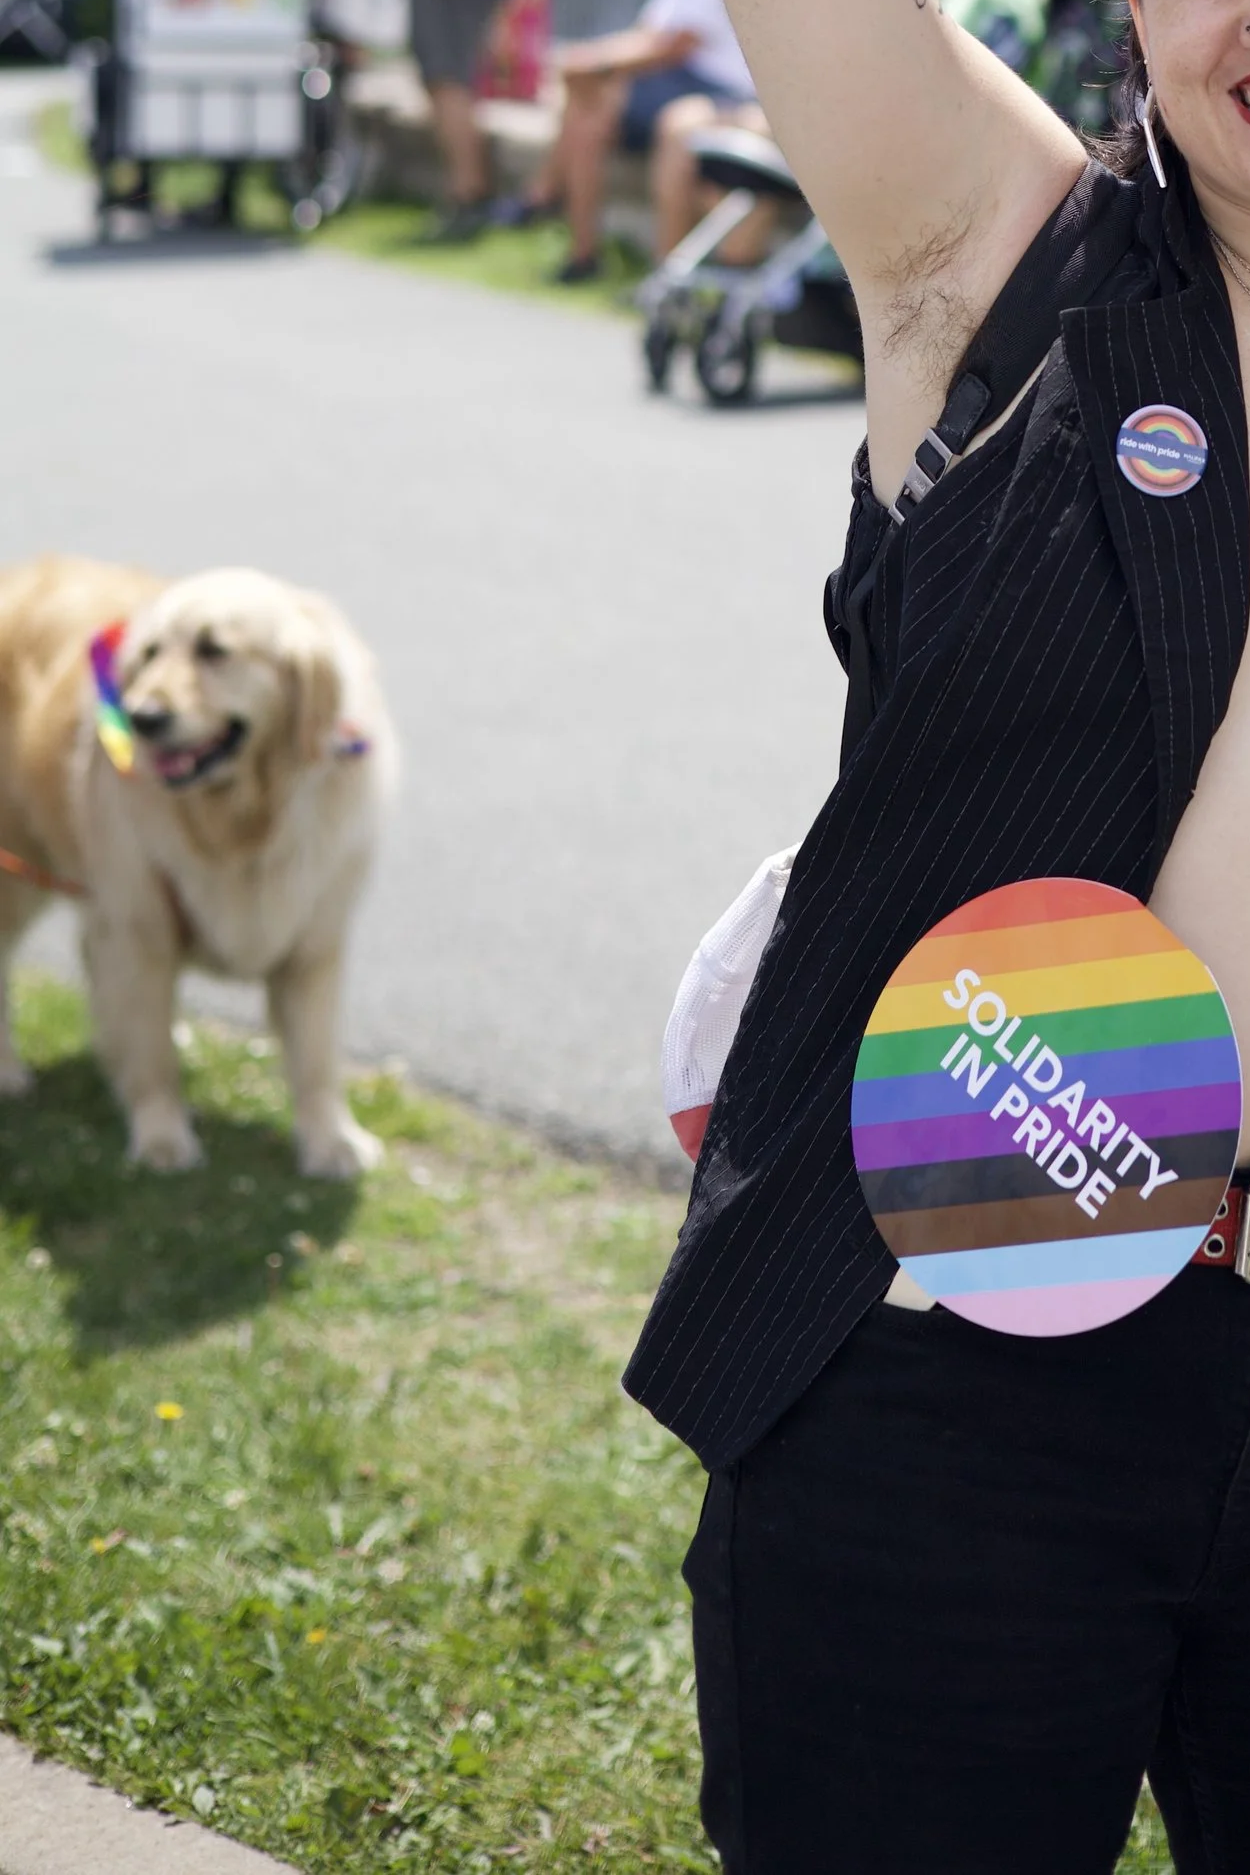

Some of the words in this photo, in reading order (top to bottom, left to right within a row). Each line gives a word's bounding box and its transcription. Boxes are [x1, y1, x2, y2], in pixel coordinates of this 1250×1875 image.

[1119, 436, 1138, 449] ride
[1138, 441, 1157, 453] with
[1157, 446, 1180, 459] pride
[939, 1032, 998, 1099] IN
[989, 1083, 1117, 1220] PRIDE
[942, 968, 1179, 1201] SOLIDARITY
